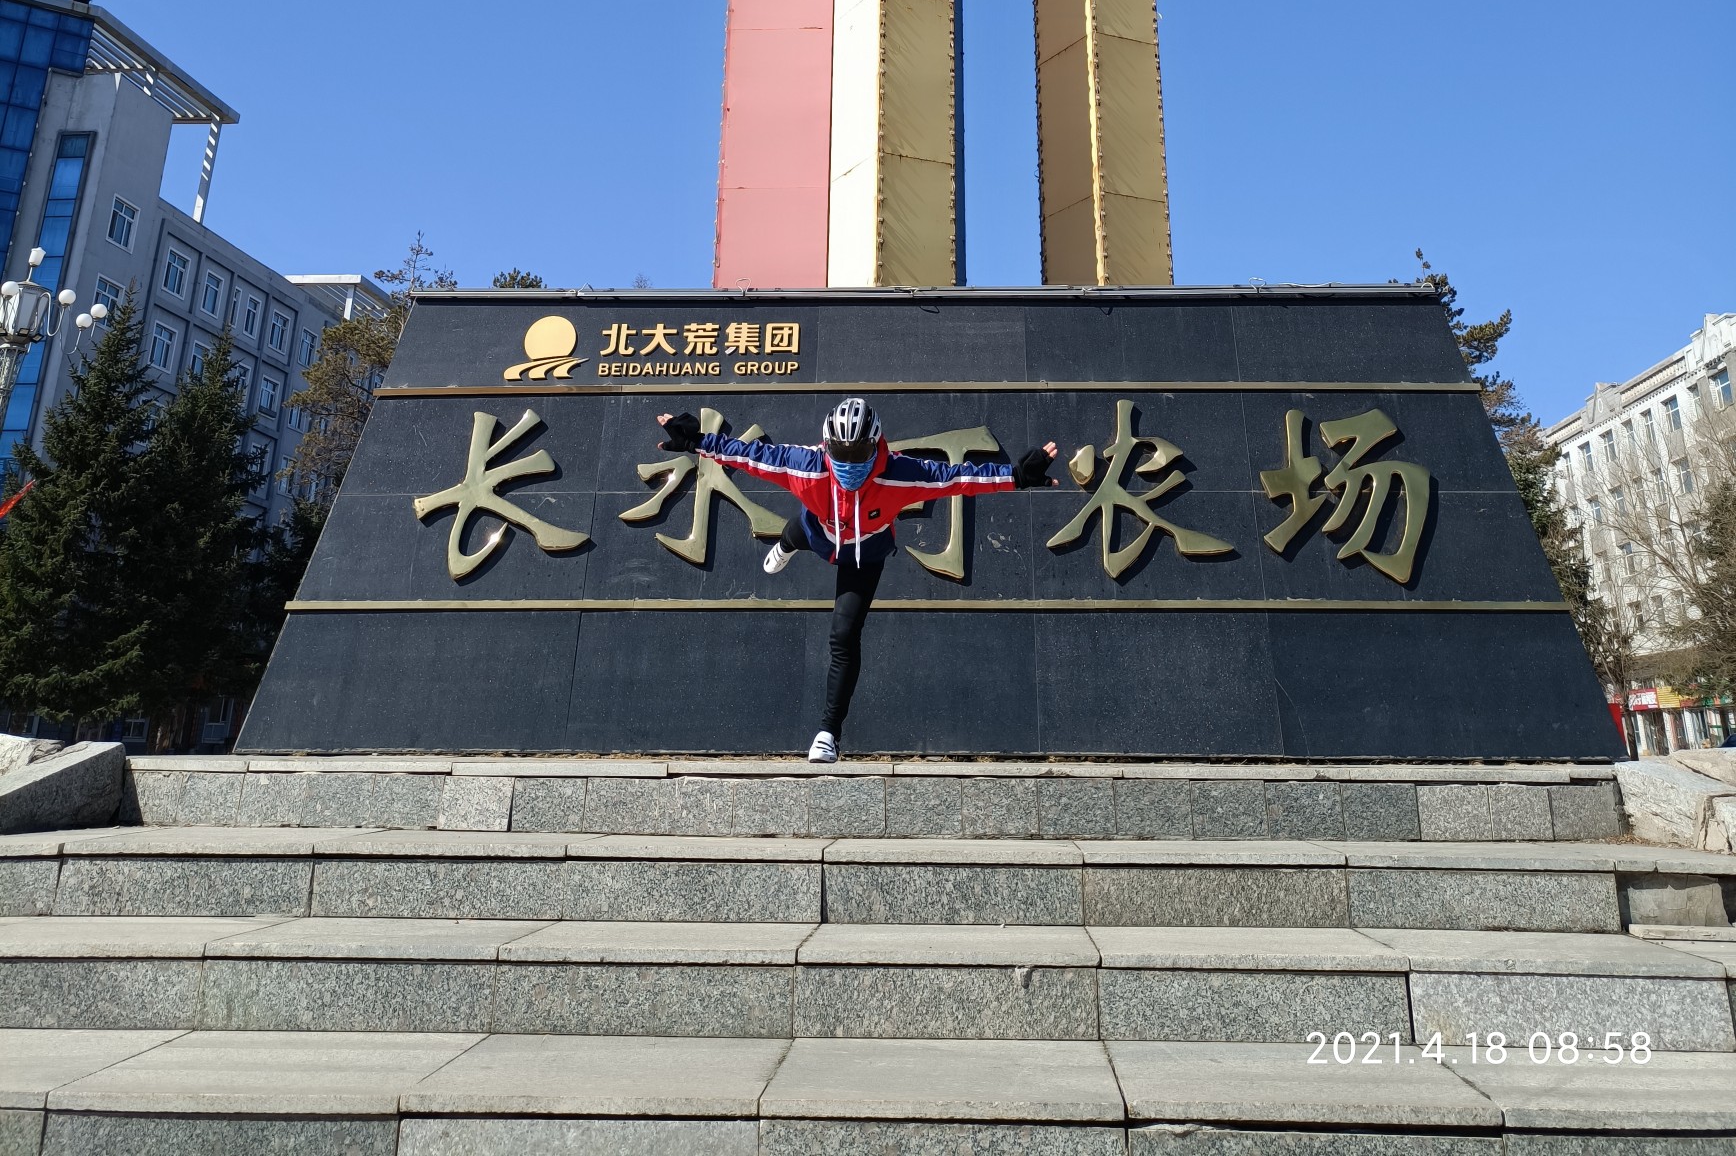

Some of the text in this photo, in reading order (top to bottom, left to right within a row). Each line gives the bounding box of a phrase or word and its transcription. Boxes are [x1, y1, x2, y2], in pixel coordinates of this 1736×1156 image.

[600, 323, 800, 356] 北大荒集团
[598, 361, 799, 377] BEIDAHUANG GROUP
